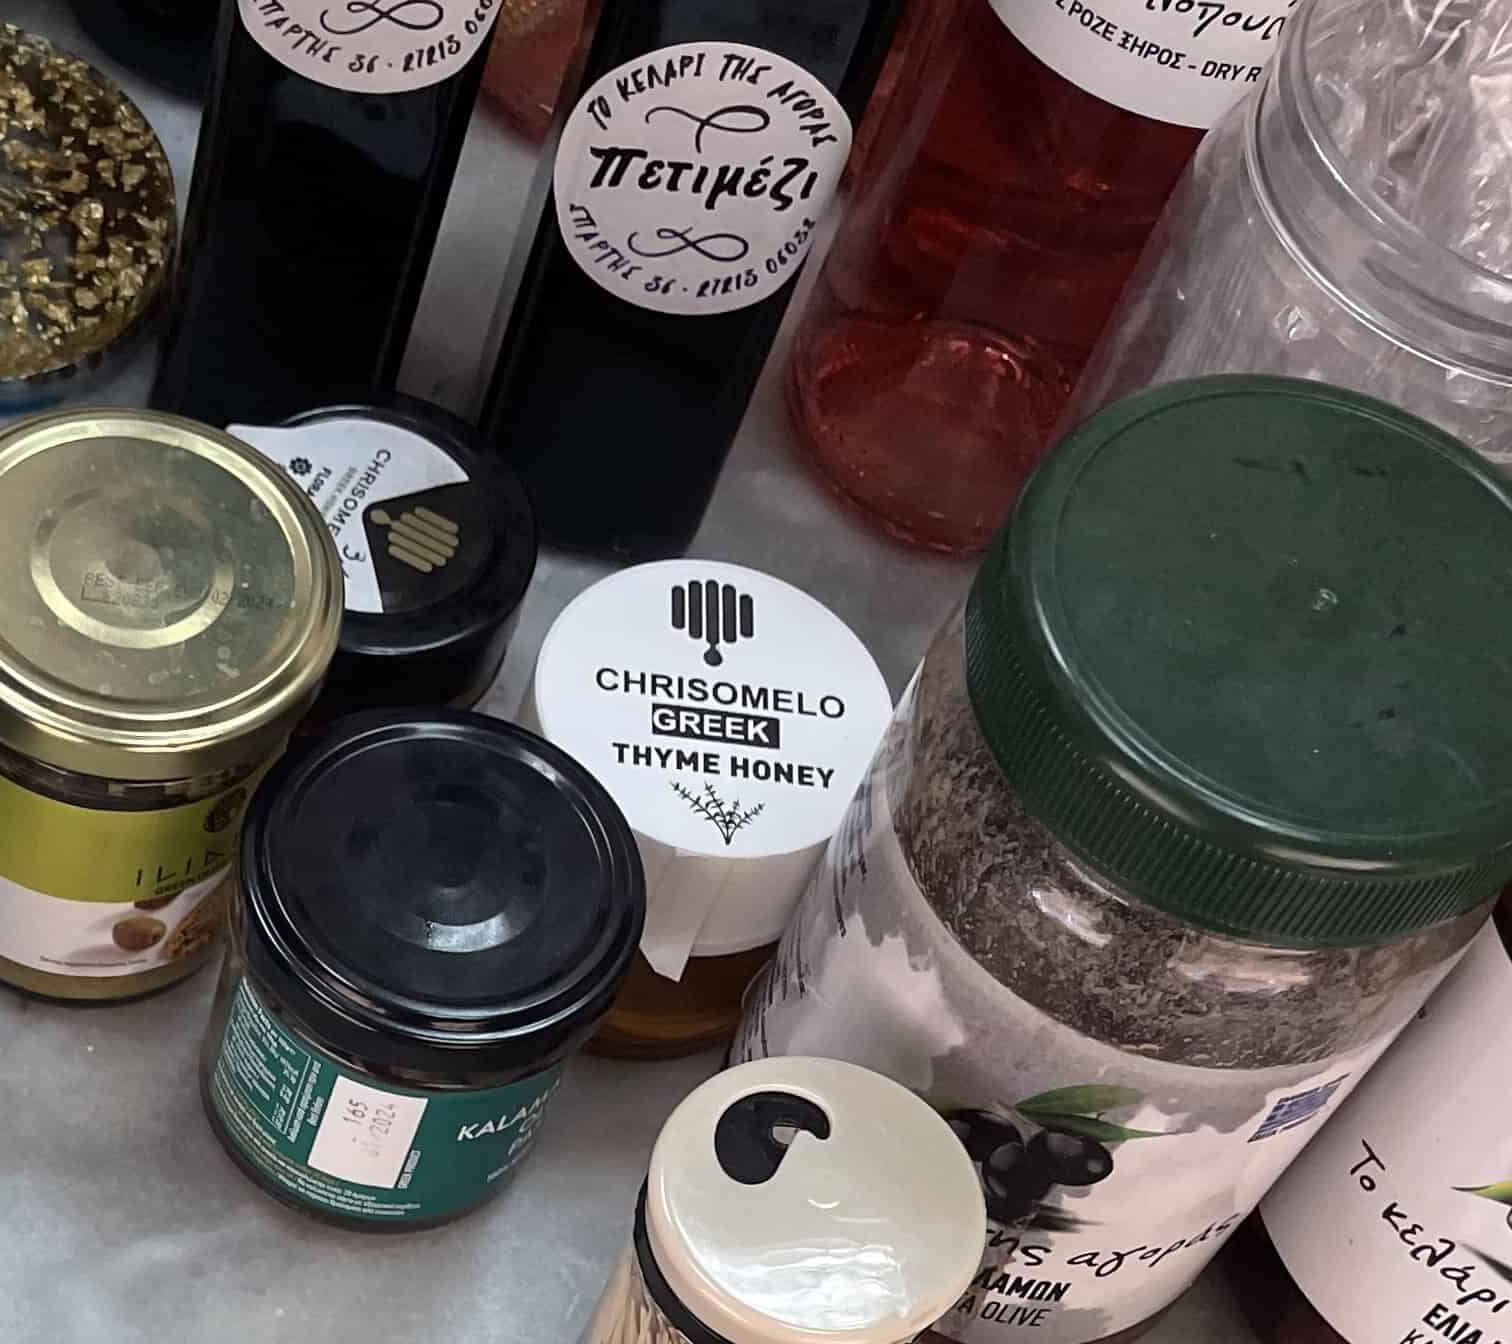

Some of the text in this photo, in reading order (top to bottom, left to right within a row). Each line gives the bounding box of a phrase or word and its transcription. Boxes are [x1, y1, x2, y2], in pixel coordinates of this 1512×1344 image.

[255, 0, 342, 62] ΠΑΡΤΗΣ
[1068, 5, 1118, 42] ΡΟΖΕ
[1200, 60, 1246, 81] DRY
[587, 95, 612, 130] ΤΟ
[719, 53, 772, 84] ΤΗΣ
[589, 146, 819, 212] Πετιμέζι
[596, 667, 845, 719] CHRISOMELO
[652, 707, 771, 744] GREEK
[612, 742, 835, 788] THYME HONEY
[1382, 1202, 1510, 1313] κελάρι
[980, 1301, 1052, 1327] OLIVE
